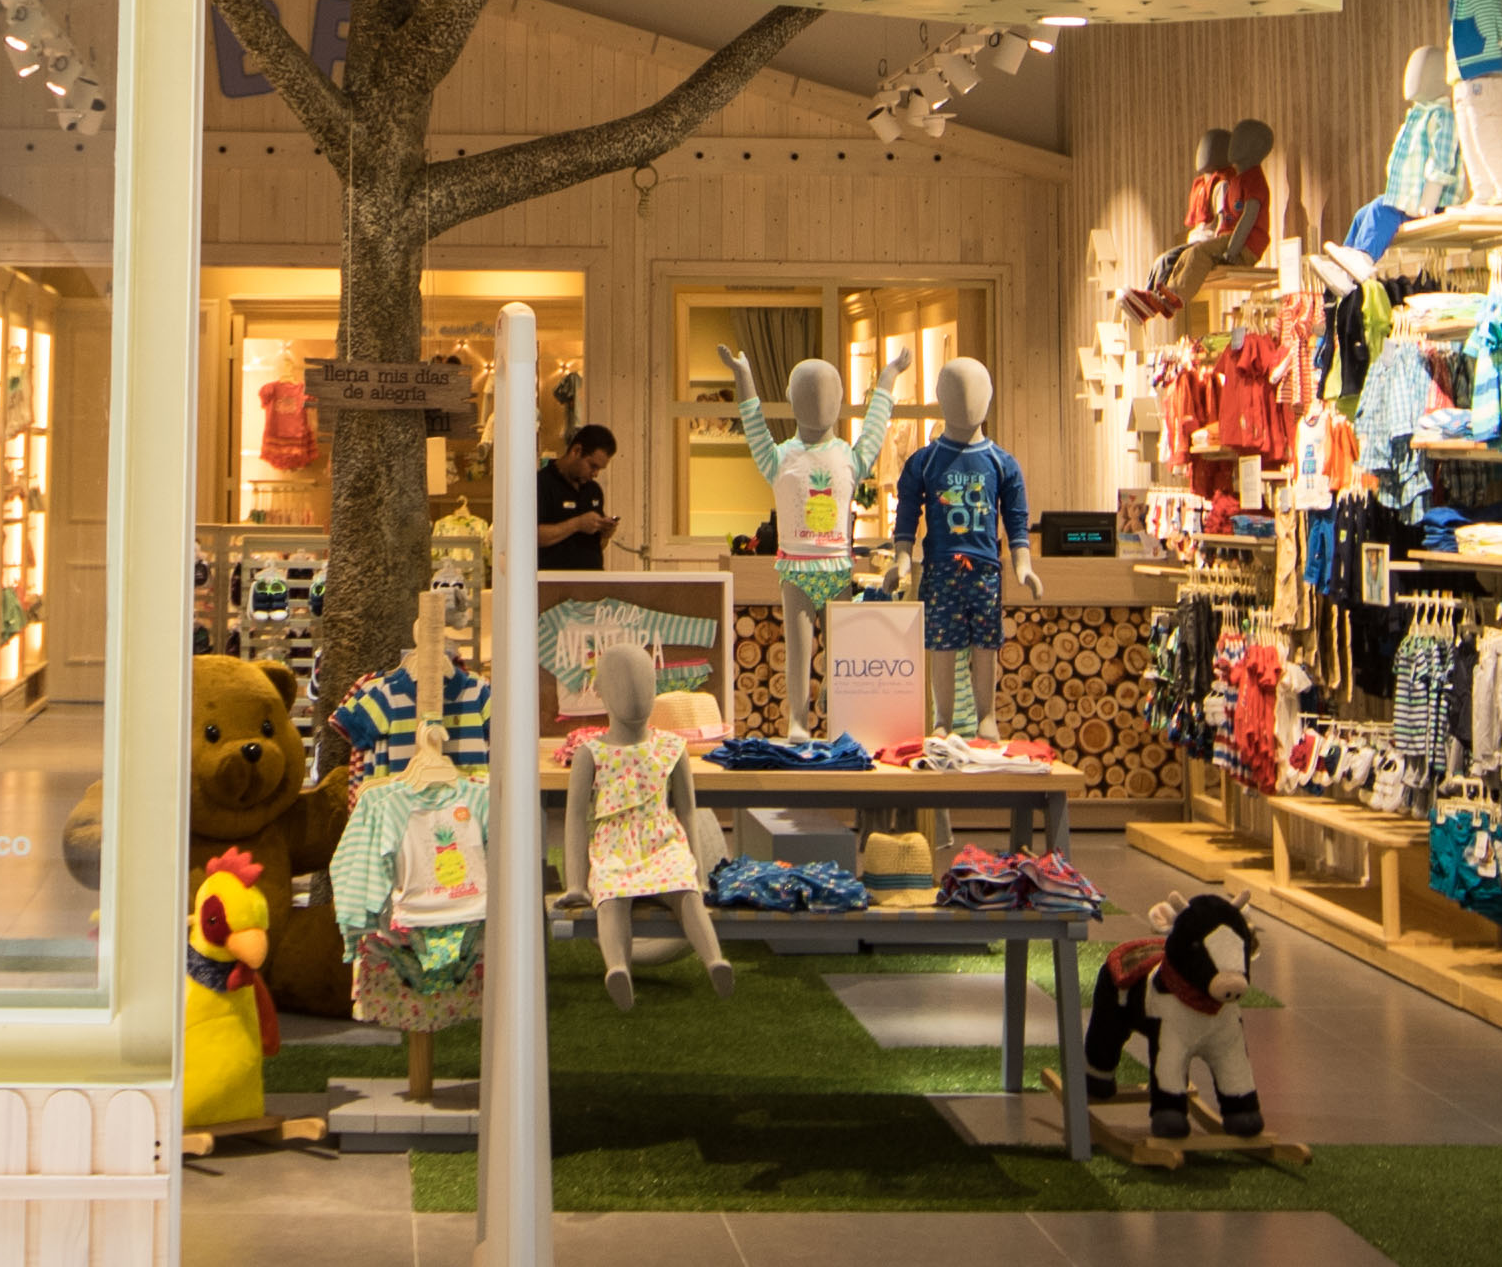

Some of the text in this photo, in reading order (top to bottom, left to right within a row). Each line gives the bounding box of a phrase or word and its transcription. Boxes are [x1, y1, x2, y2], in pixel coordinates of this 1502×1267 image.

[323, 365, 369, 382] llena
[378, 370, 408, 383] mis
[343, 384, 363, 399] de
[946, 473, 986, 486] SUPER
[834, 659, 914, 677] nuevo
